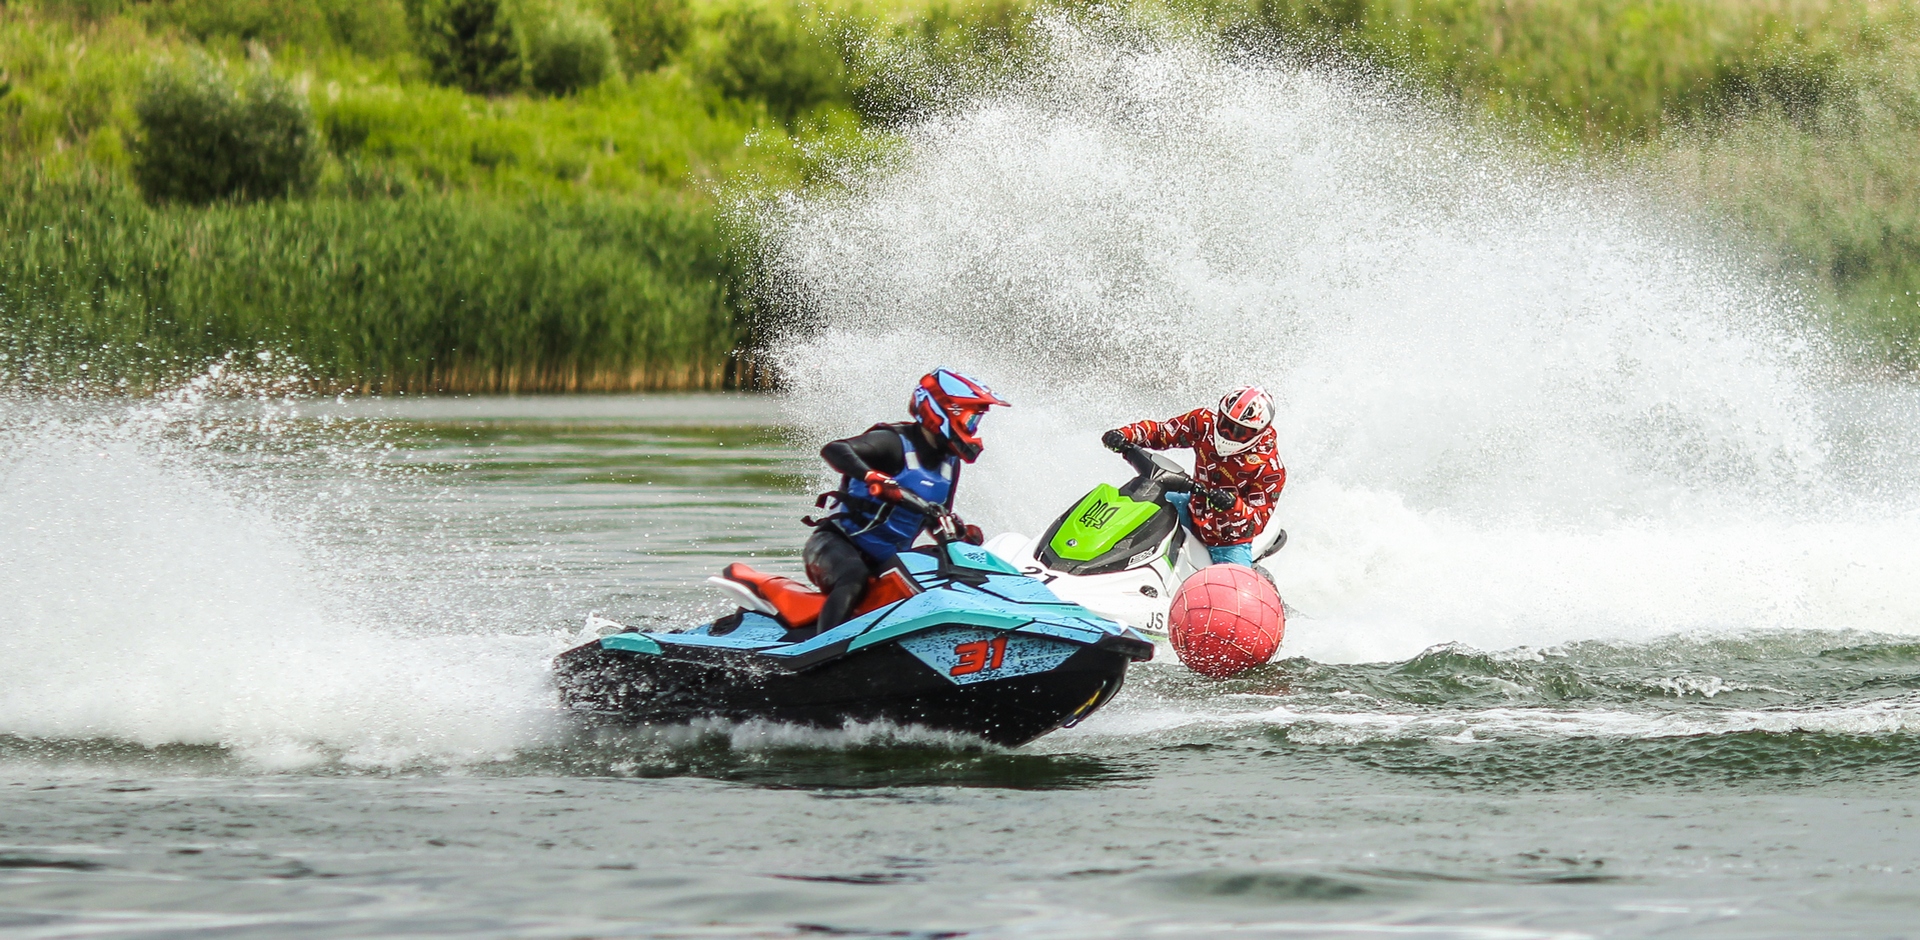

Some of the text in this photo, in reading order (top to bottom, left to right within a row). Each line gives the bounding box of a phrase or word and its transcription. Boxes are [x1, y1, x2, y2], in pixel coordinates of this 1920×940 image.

[1022, 566, 1059, 585] 21
[1146, 612, 1165, 630] JS
[949, 637, 1008, 676] 31
